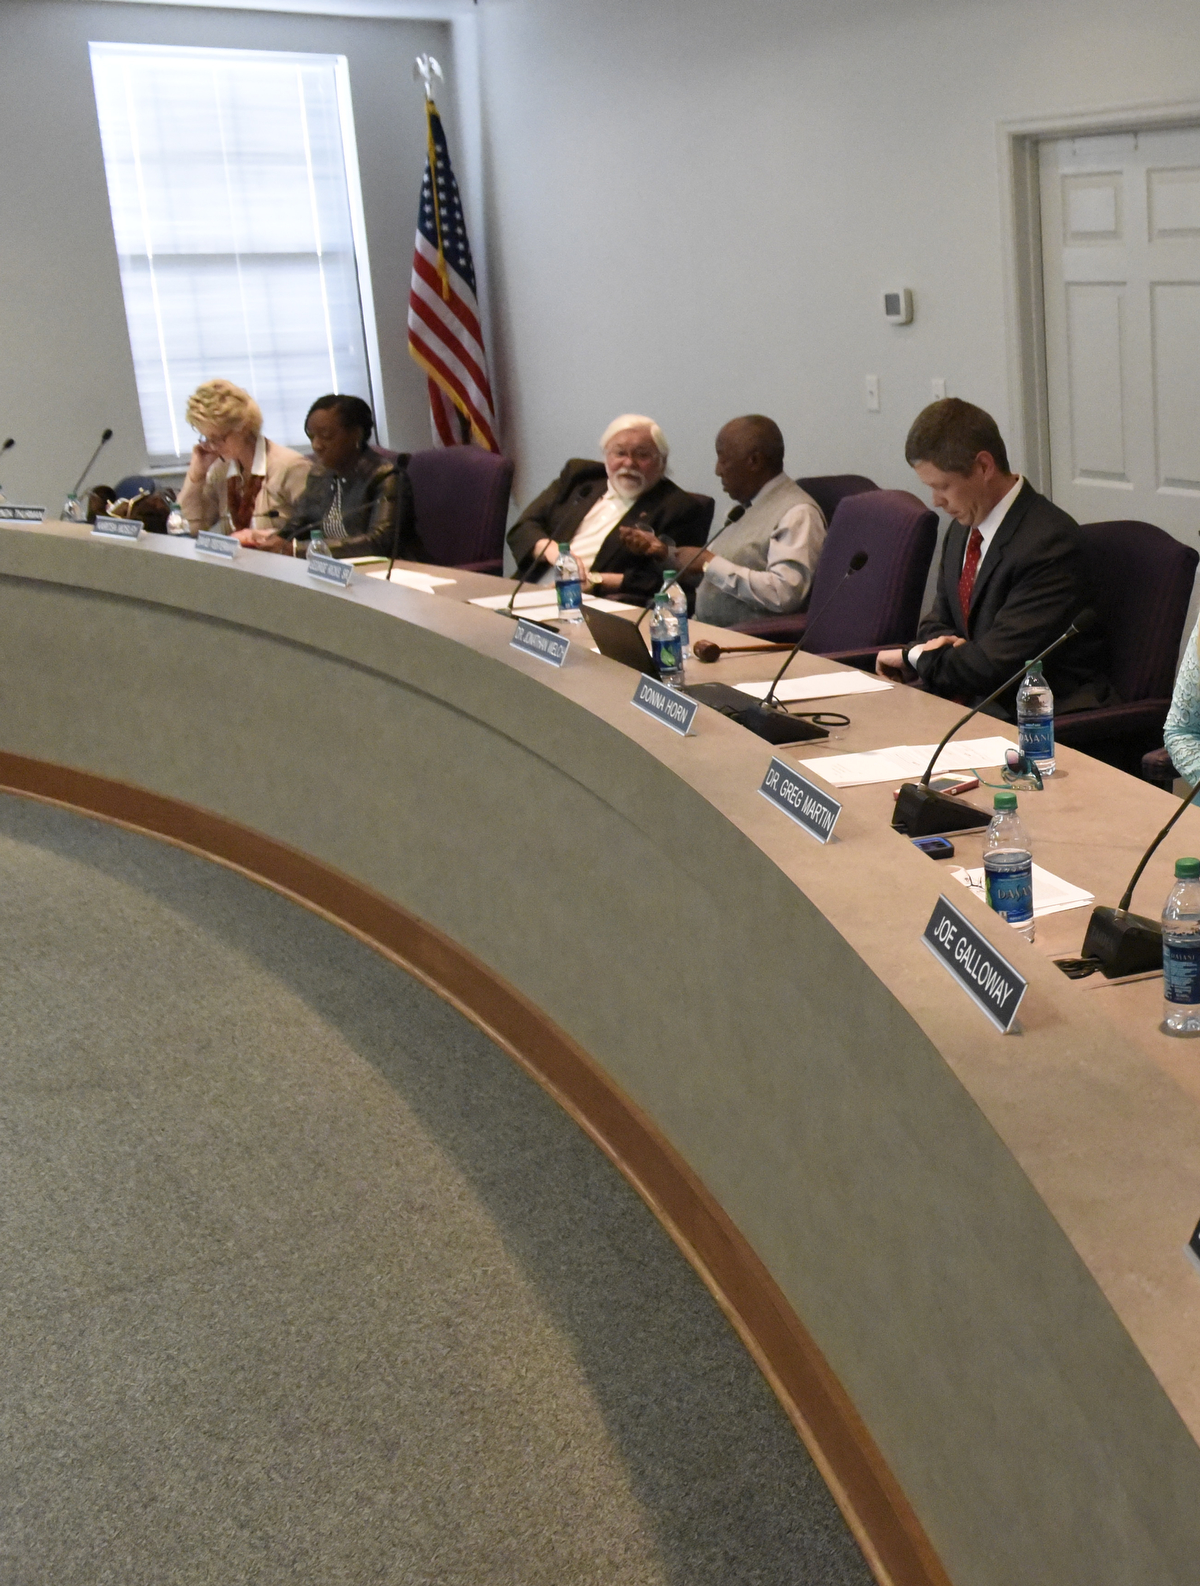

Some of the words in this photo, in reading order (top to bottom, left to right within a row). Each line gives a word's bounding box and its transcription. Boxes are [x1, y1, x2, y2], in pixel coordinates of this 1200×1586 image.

[639, 684, 666, 711] DONNA
[664, 699, 689, 725] HORN
[765, 768, 780, 792] DR.
[779, 779, 804, 808] GREG
[801, 795, 835, 832] MARTIN
[997, 884, 1033, 901] DASAN
[933, 915, 958, 951] JOE
[954, 936, 1014, 1009] GALLOWAY
